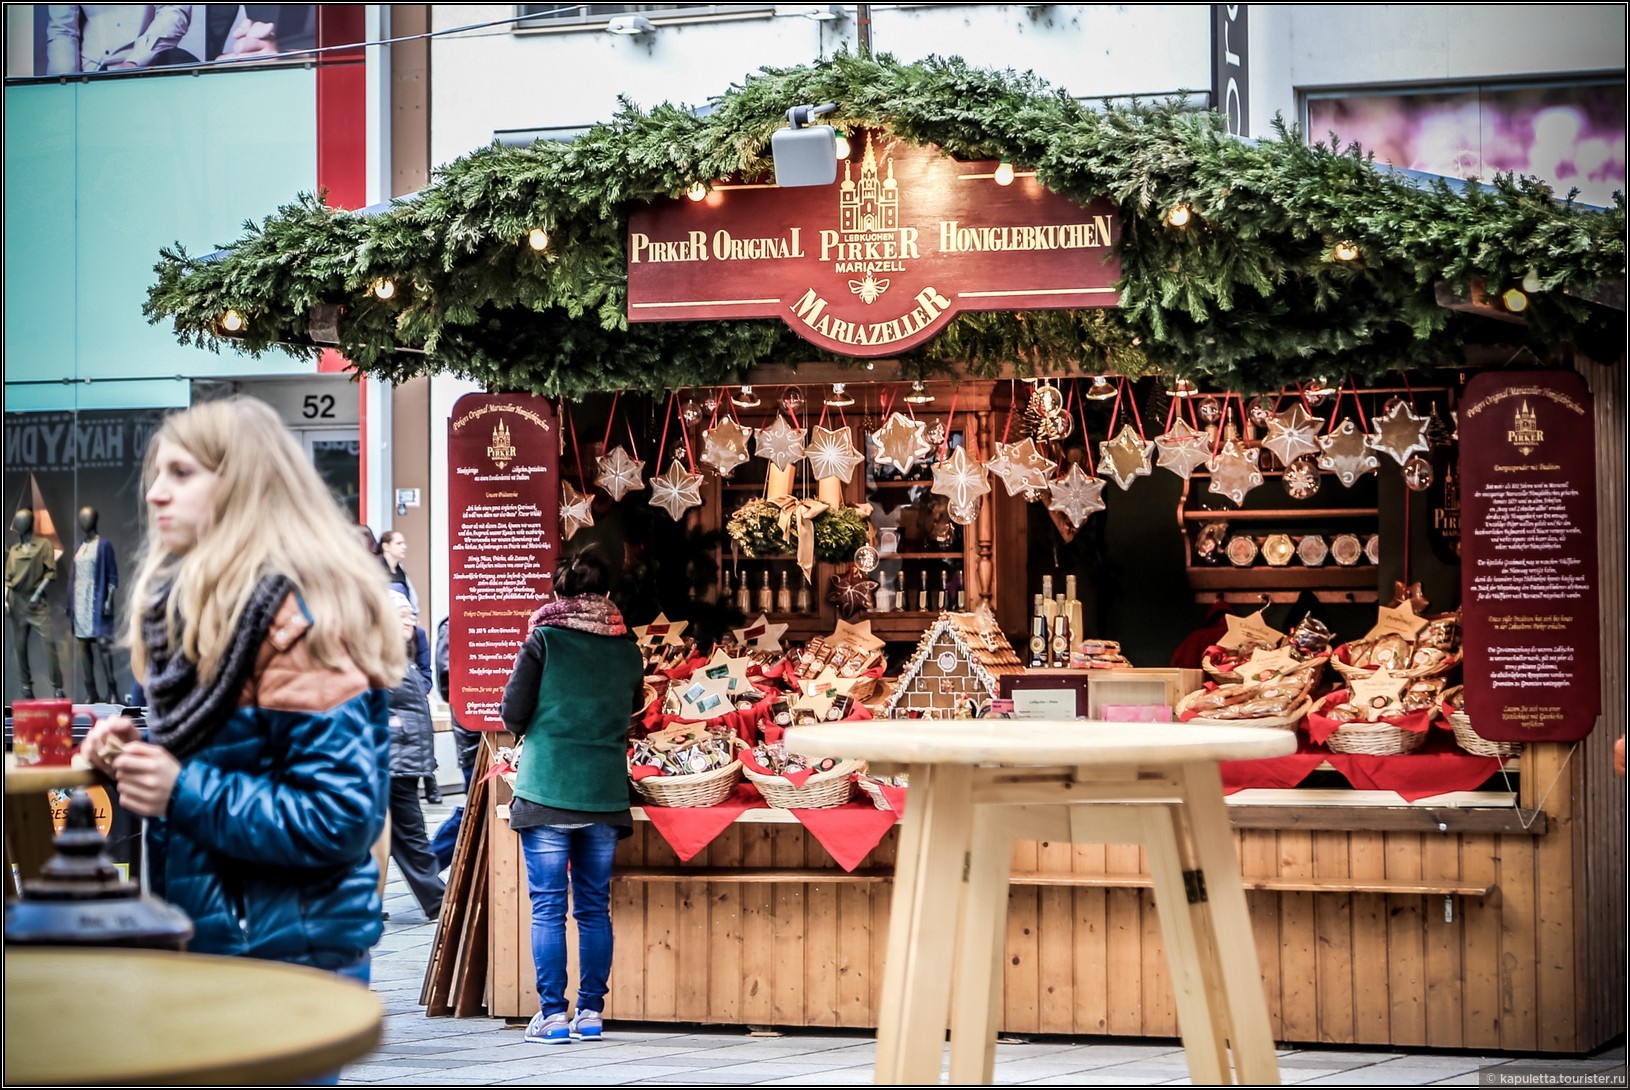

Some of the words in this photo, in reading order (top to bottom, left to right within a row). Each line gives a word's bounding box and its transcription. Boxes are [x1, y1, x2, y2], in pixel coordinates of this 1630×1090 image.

[631, 230, 709, 264] PIRKER
[712, 227, 805, 262] ORIGINAL
[818, 227, 921, 262] PIRKER
[843, 233, 894, 242] LEBKUCHEN
[938, 215, 1113, 253] HONIGLEBKUCHEN
[835, 260, 906, 273] MARIAZELL
[789, 286, 952, 346] MARIAZELLER
[302, 394, 335, 419] 52
[1507, 430, 1544, 442] PIRKER
[487, 446, 516, 457] PIRKER
[1434, 508, 1460, 529] PIR
